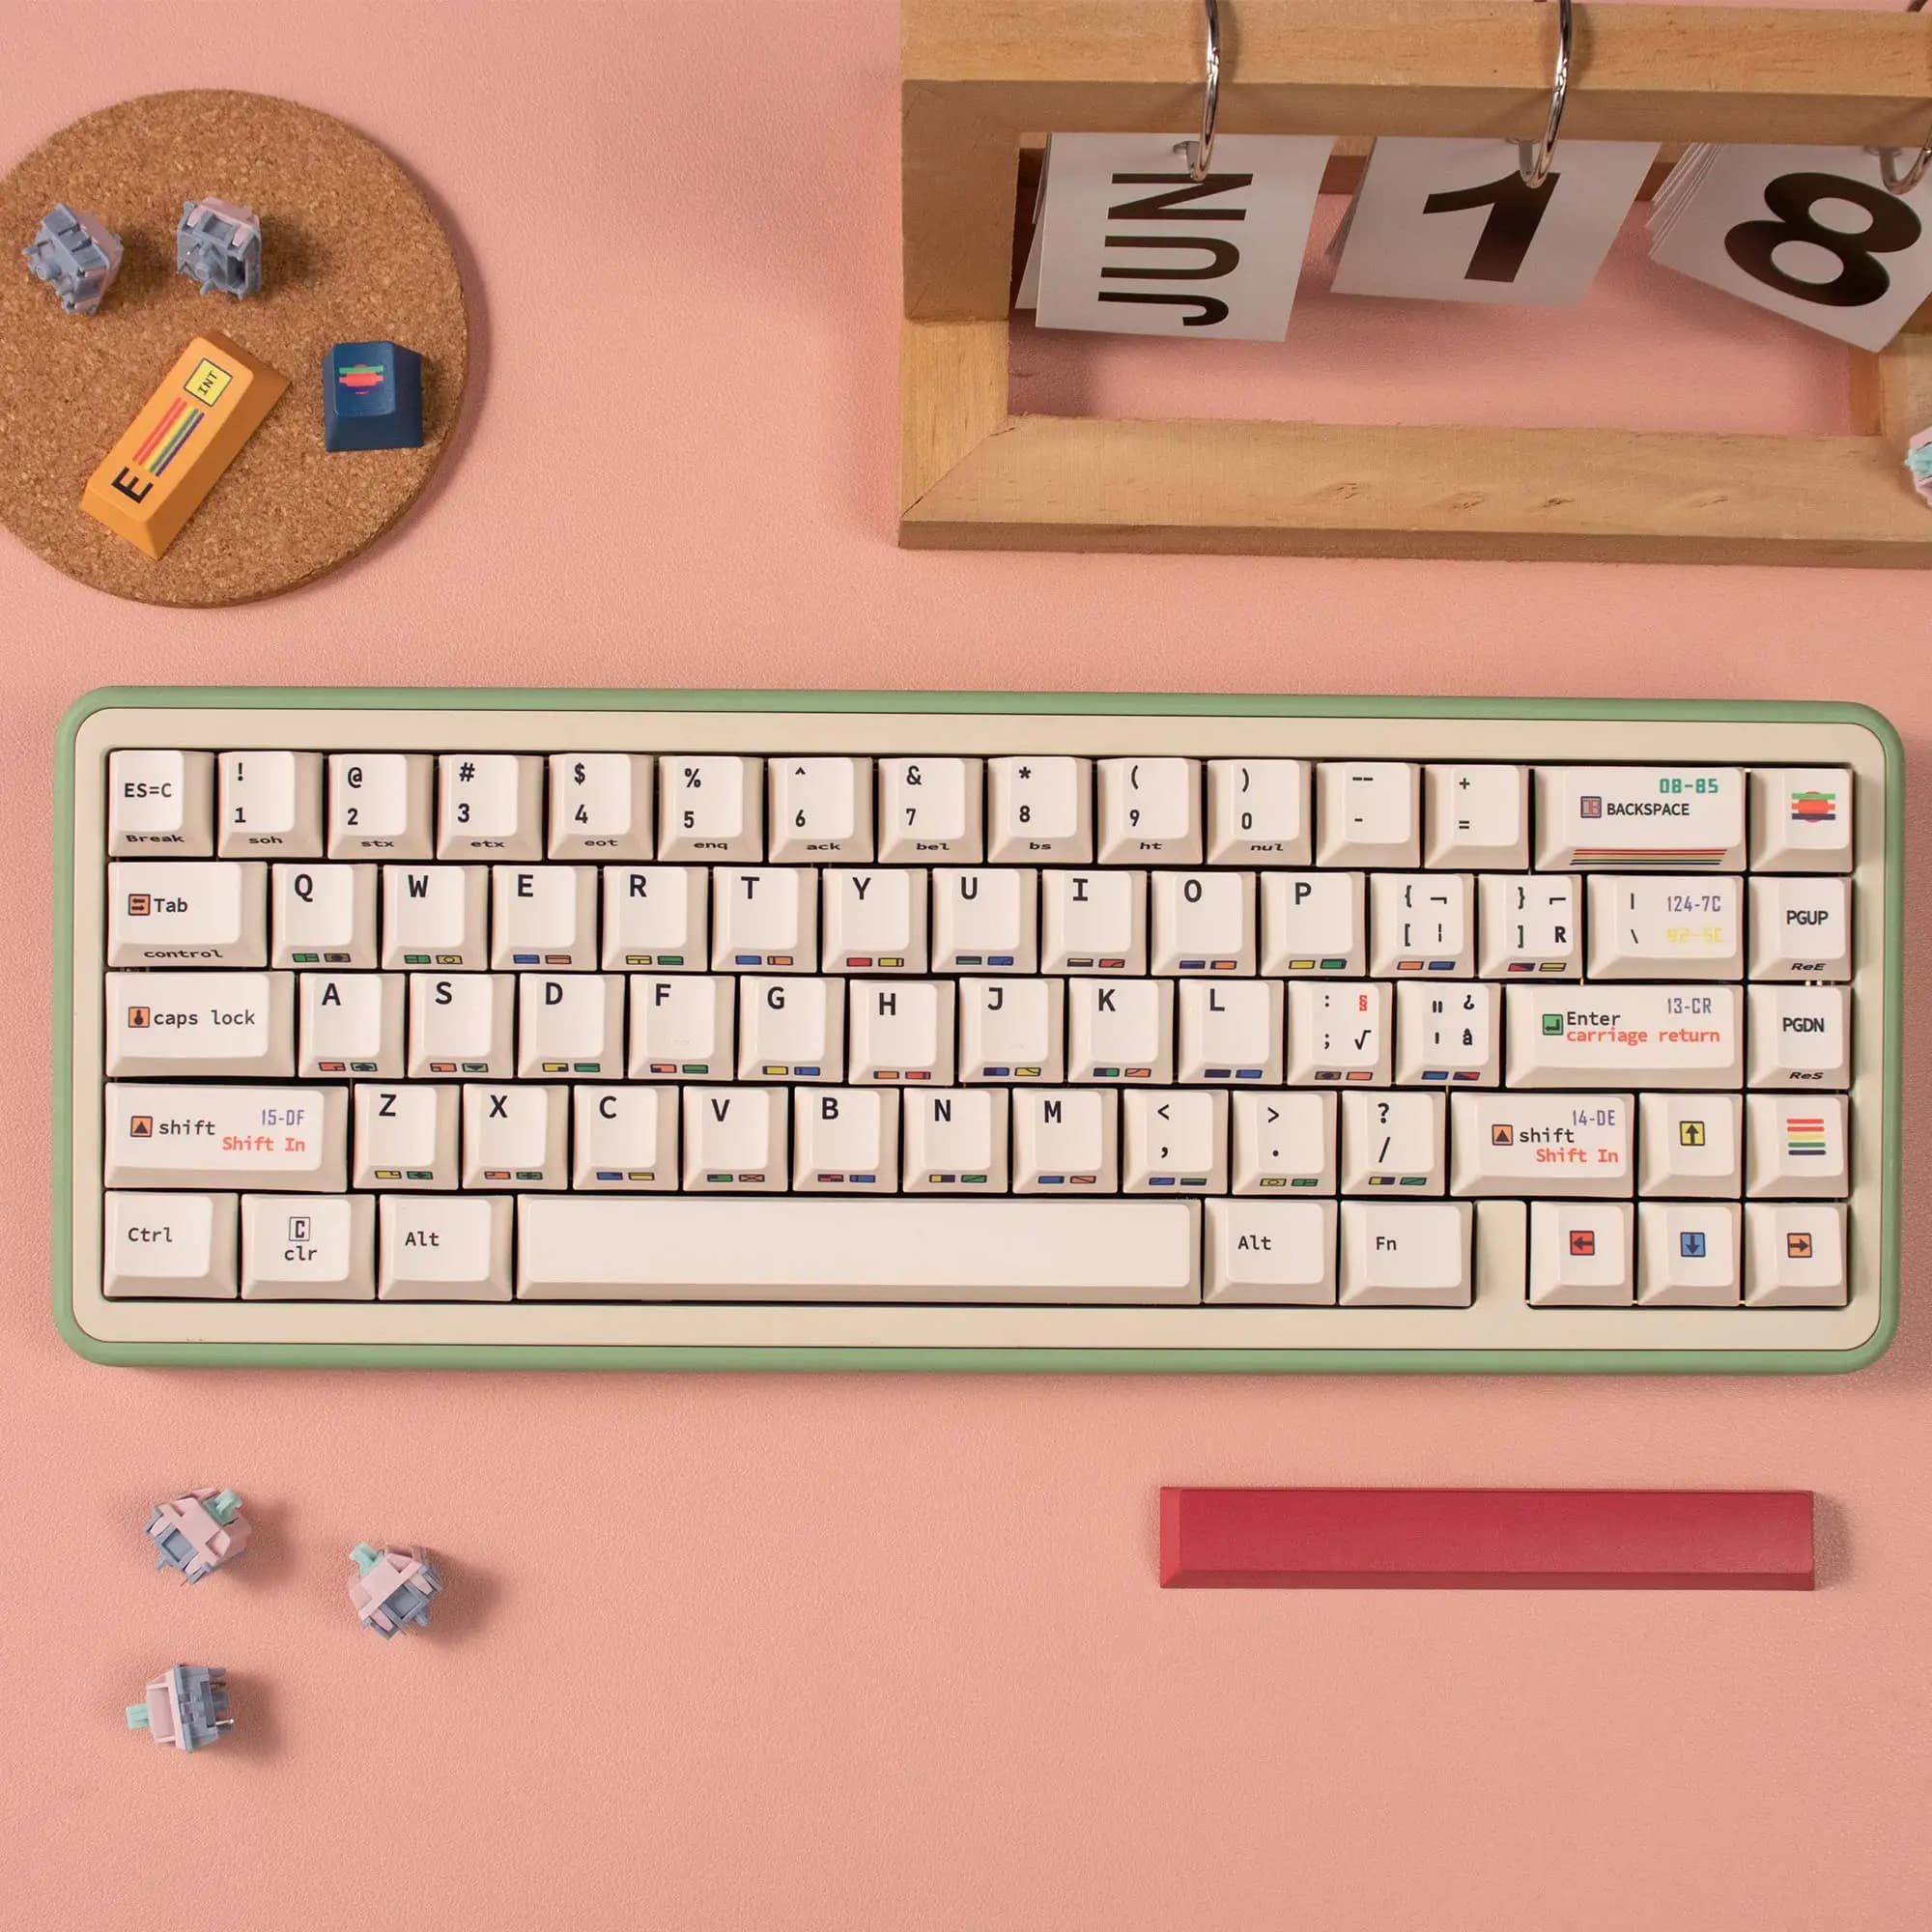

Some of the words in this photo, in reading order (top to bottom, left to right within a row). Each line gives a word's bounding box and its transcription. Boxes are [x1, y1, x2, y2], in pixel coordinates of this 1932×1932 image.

[1422, 172, 1561, 282] 1
[1097, 172, 1254, 327] JUN
[1723, 172, 1921, 307] 8
[198, 370, 218, 396] INT
[111, 468, 153, 503] E
[238, 763, 242, 781] !
[348, 767, 362, 788] @
[460, 762, 475, 781] #
[575, 763, 585, 785] $
[685, 768, 700, 787] %
[907, 765, 922, 784] &
[1131, 765, 1138, 789] (
[1242, 768, 1249, 792] )
[1460, 778, 1470, 789] +
[235, 808, 245, 823] 1
[348, 808, 357, 825] 2
[458, 804, 469, 822] 3
[575, 805, 587, 823] 4
[684, 811, 694, 828] 5
[796, 810, 805, 827] 6
[906, 809, 916, 825] 7
[1020, 806, 1030, 822] 8
[1130, 810, 1139, 826] 9
[1607, 804, 1690, 815] BACKSPACE
[295, 874, 313, 902] Q
[409, 874, 428, 897] W
[518, 874, 533, 896] E
[630, 874, 646, 896] R
[741, 876, 759, 899] T
[853, 877, 870, 899] Y
[961, 877, 978, 899] U
[1073, 878, 1088, 901] I
[1184, 879, 1202, 902] O
[1295, 882, 1311, 904] P
[154, 897, 187, 912] Tab
[1405, 885, 1411, 908] {
[1518, 887, 1524, 909] }
[1787, 910, 1829, 924] PGUP
[1405, 923, 1410, 947] [
[1518, 925, 1523, 949] ]
[1555, 926, 1566, 943] R
[322, 983, 340, 1006] A
[436, 981, 452, 1005] S
[546, 982, 562, 1005] D
[656, 983, 670, 1006] F
[768, 986, 784, 1009] G
[879, 993, 895, 1015] H
[988, 987, 1003, 1010] J
[1099, 988, 1116, 1011] K
[1210, 988, 1225, 1011] L
[155, 1014, 198, 1028] caps
[212, 1009, 254, 1025] lock
[1567, 1012, 1621, 1026] Enter
[1783, 1017, 1824, 1032] PGDN
[1567, 1028, 1648, 1045] carriage
[1660, 1029, 1719, 1042] return
[379, 1094, 396, 1117] Z
[490, 1095, 507, 1118] X
[600, 1096, 616, 1119] C
[711, 1099, 729, 1122] V
[822, 1097, 838, 1120] B
[935, 1099, 951, 1122] N
[1044, 1100, 1061, 1123] M
[1158, 1104, 1169, 1120] <
[1268, 1107, 1279, 1122] >
[1378, 1103, 1389, 1123] ?
[159, 1120, 214, 1135] shift
[1520, 1127, 1575, 1143] shift
[222, 1136, 273, 1151] Shift
[286, 1138, 305, 1151] In
[1378, 1137, 1390, 1162] /
[1537, 1148, 1587, 1162] Shift
[1598, 1150, 1618, 1162] In
[128, 1228, 172, 1242] Ctrl
[295, 1219, 305, 1238] C
[405, 1232, 439, 1246] Alt
[285, 1245, 317, 1261] clr
[1238, 1236, 1270, 1250] Alt
[1377, 1236, 1396, 1250] Fn
